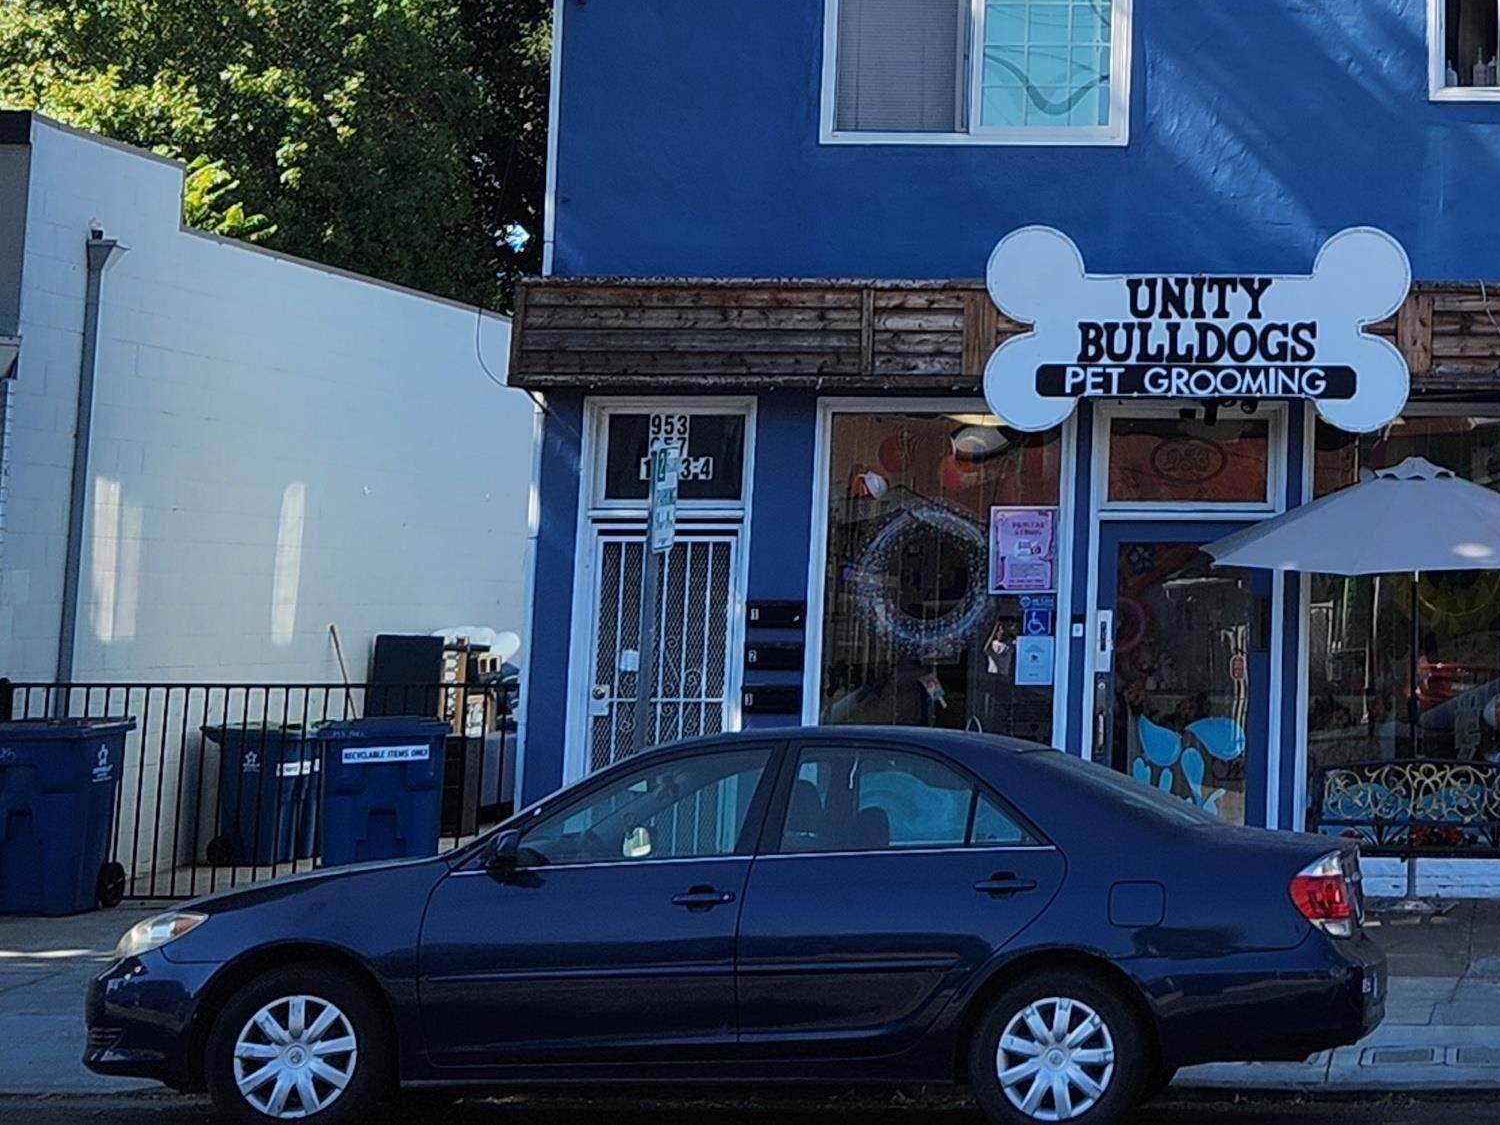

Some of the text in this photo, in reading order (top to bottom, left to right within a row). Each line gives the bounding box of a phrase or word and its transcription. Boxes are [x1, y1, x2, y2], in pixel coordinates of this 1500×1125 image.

[1126, 278, 1273, 319] UNITY
[1077, 321, 1318, 363] BULLDOGS
[1064, 367, 1327, 395] PET GROOMING
[650, 415, 688, 435] 953
